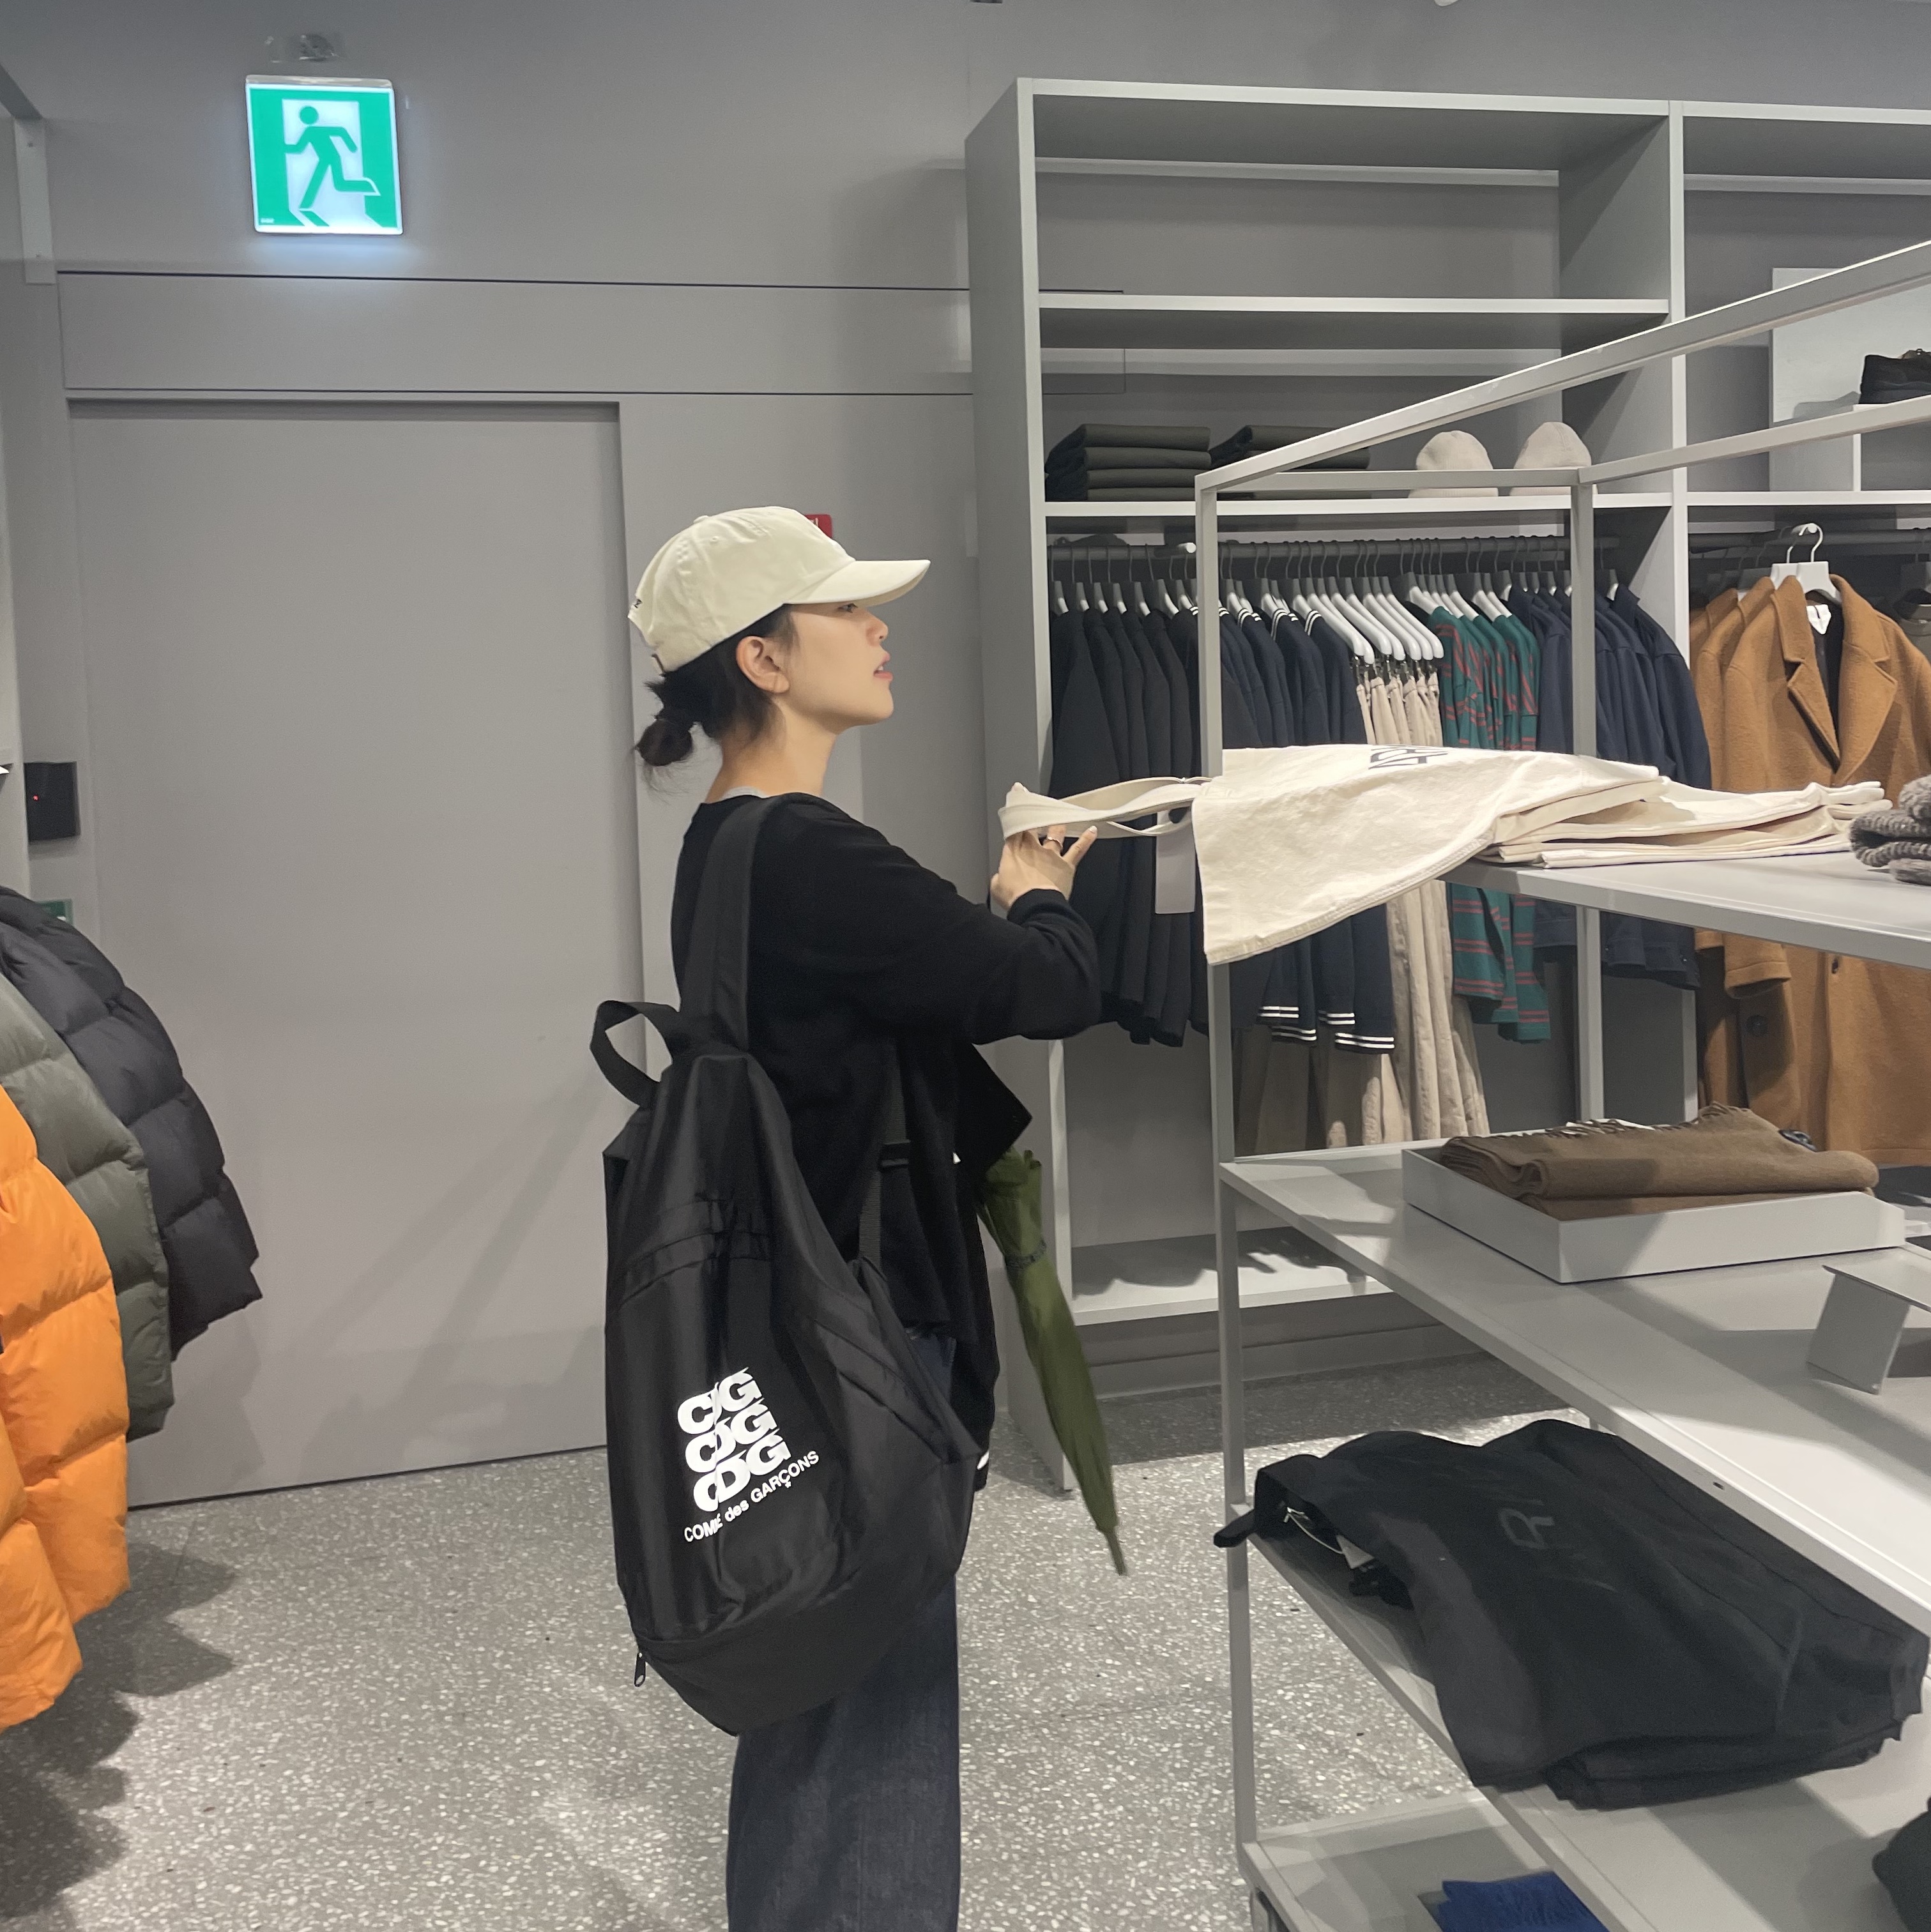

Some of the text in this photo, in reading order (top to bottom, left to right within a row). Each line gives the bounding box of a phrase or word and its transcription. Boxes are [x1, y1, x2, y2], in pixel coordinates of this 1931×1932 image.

[694, 1428, 791, 1512] CDG
[724, 1500, 749, 1522] des
[751, 1450, 820, 1503] GARÇONS
